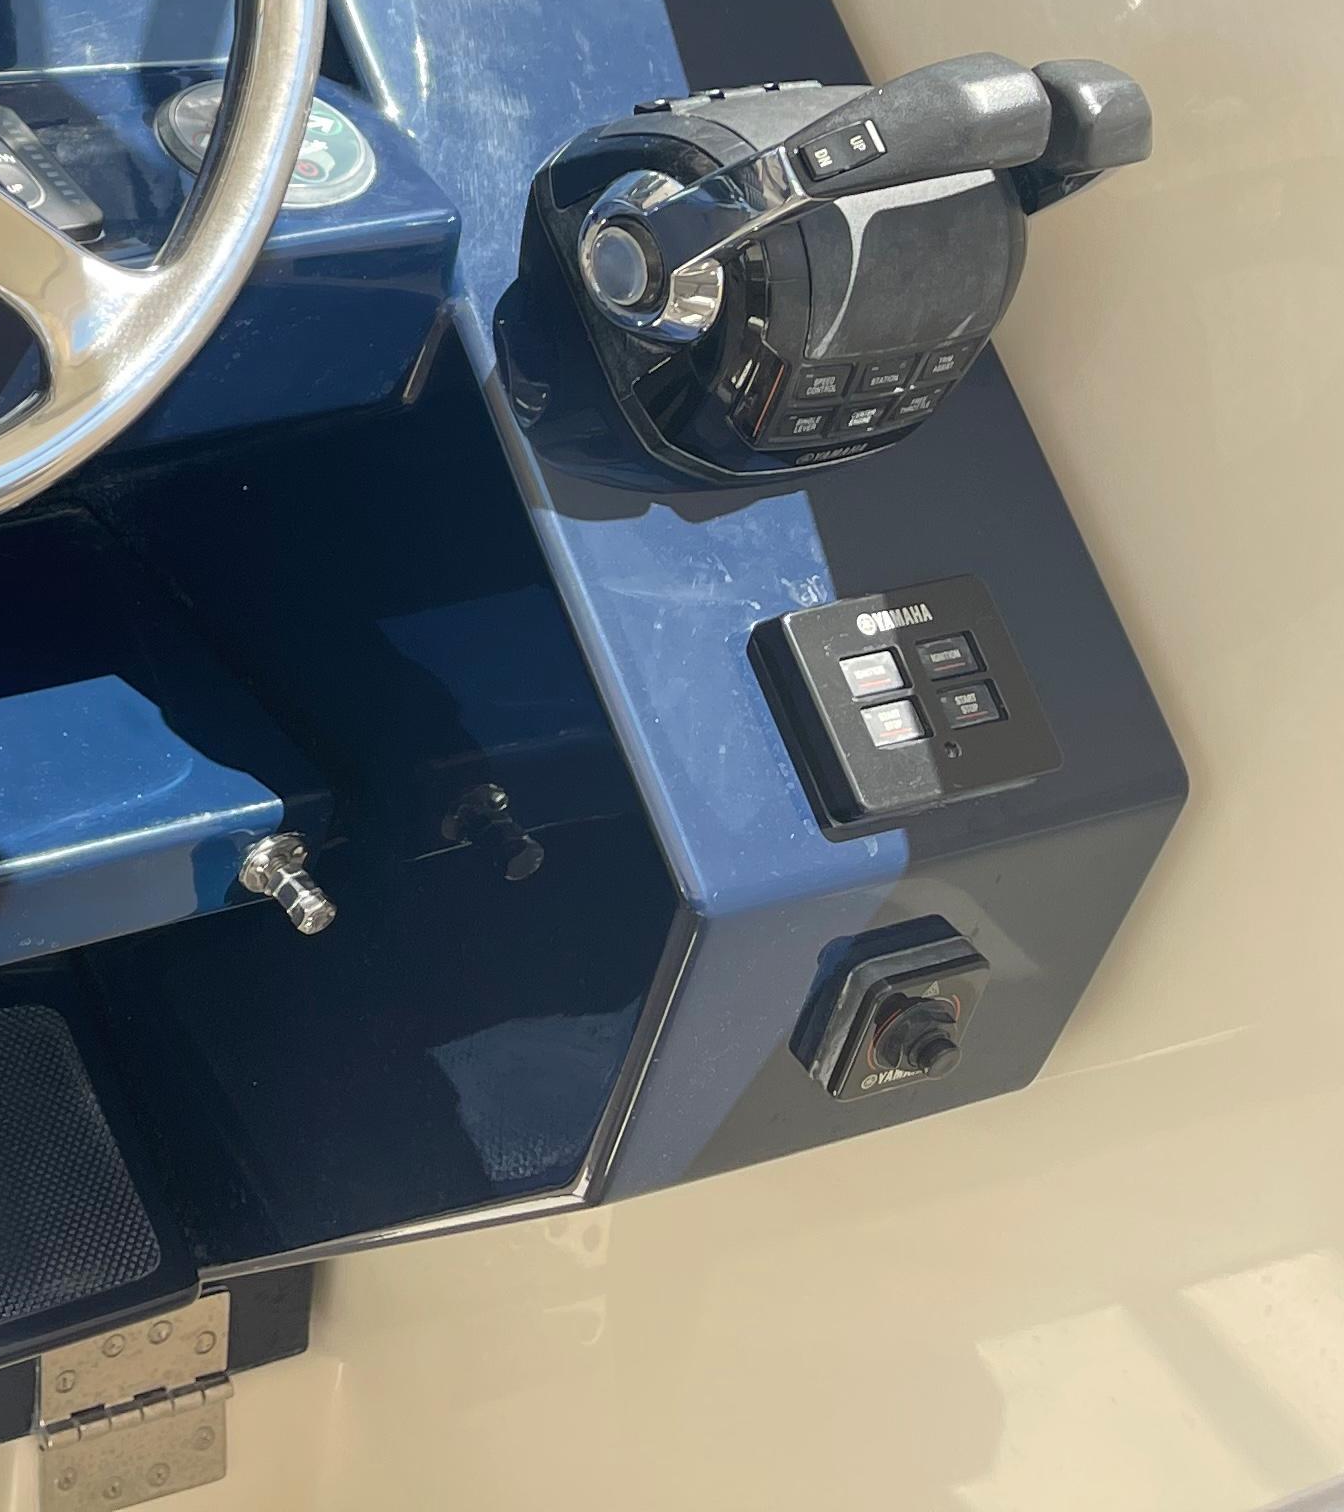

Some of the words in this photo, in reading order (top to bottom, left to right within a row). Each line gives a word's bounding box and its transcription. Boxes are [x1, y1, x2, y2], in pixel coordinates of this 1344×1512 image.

[850, 135, 866, 151] UP
[814, 148, 833, 168] DN
[6, 183, 23, 194] UP
[813, 376, 836, 387] SPEED
[870, 374, 899, 386] STATION
[806, 385, 836, 396] CONTROL
[793, 424, 818, 434] LEVER
[871, 603, 933, 632] YAMAHA
[930, 649, 961, 663] IGNITION
[954, 692, 976, 705] START
[960, 703, 979, 715] STOP
